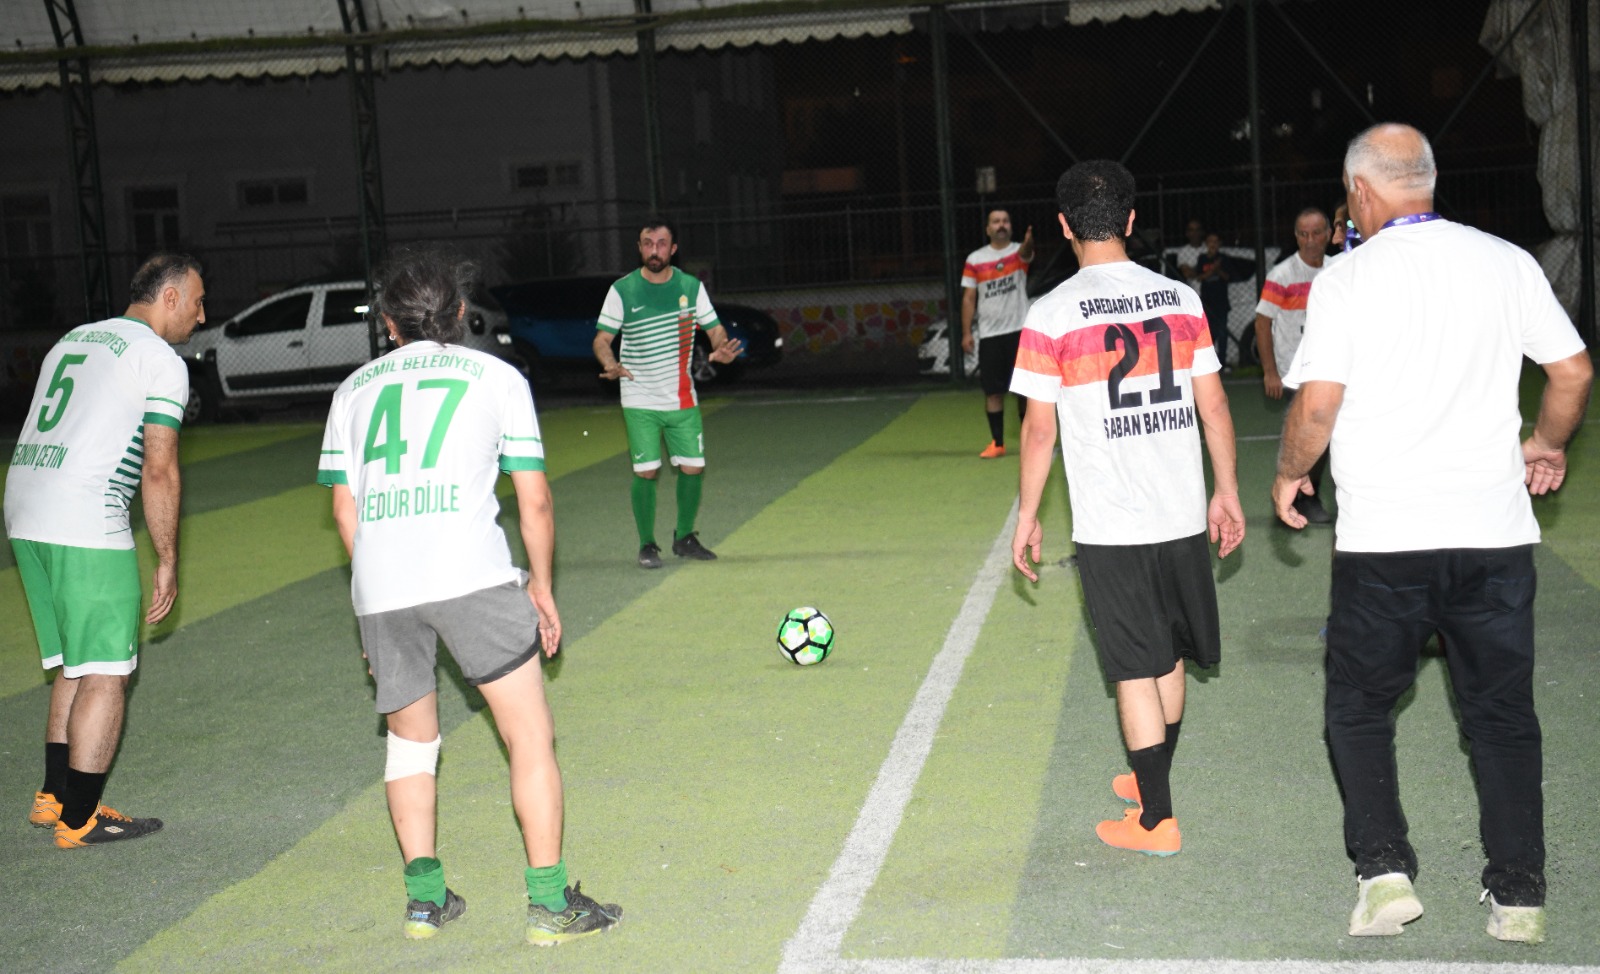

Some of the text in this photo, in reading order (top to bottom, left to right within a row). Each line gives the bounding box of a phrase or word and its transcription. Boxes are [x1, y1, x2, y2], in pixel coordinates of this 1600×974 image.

[37, 353, 88, 433] 5
[1104, 317, 1182, 410] 21
[363, 378, 470, 475] 47
[1142, 406, 1194, 434] BAYHAN
[414, 480, 460, 515] DİJLE
